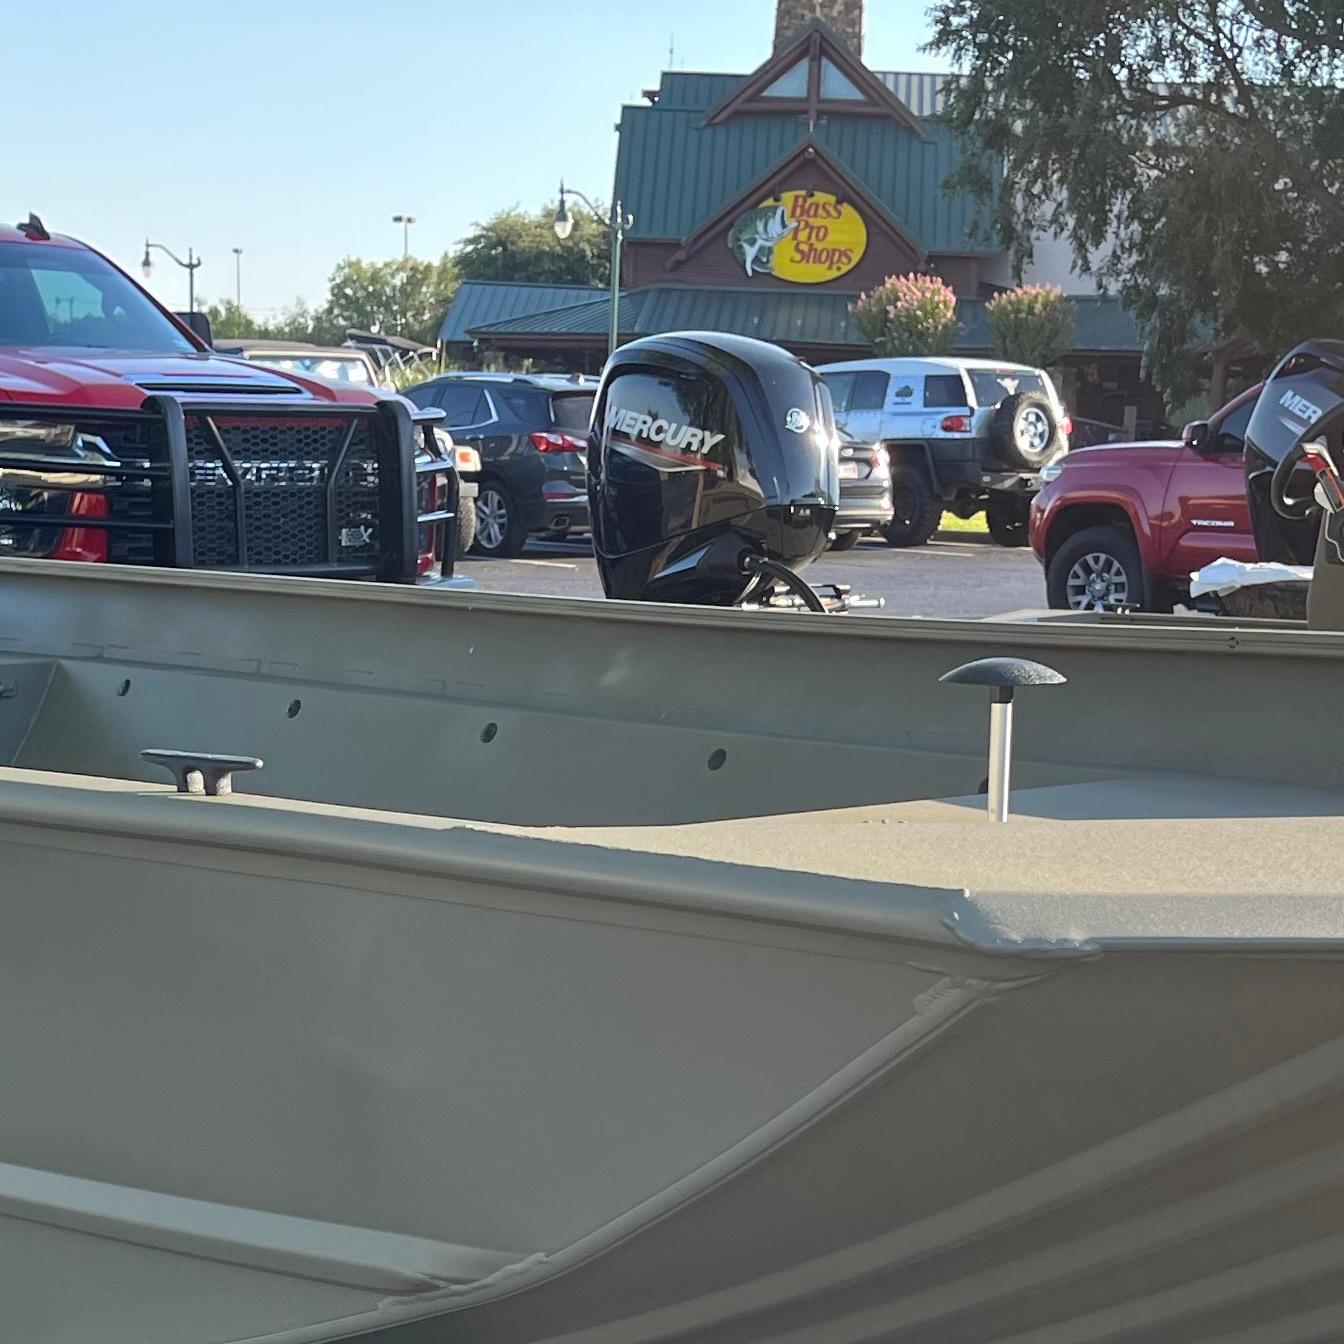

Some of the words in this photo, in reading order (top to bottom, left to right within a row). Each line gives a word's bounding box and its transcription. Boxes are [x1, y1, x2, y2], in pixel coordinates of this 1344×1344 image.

[790, 195, 843, 219] Bass
[792, 219, 828, 242] Pro
[790, 241, 853, 271] Shops
[609, 405, 725, 454] MERCURY
